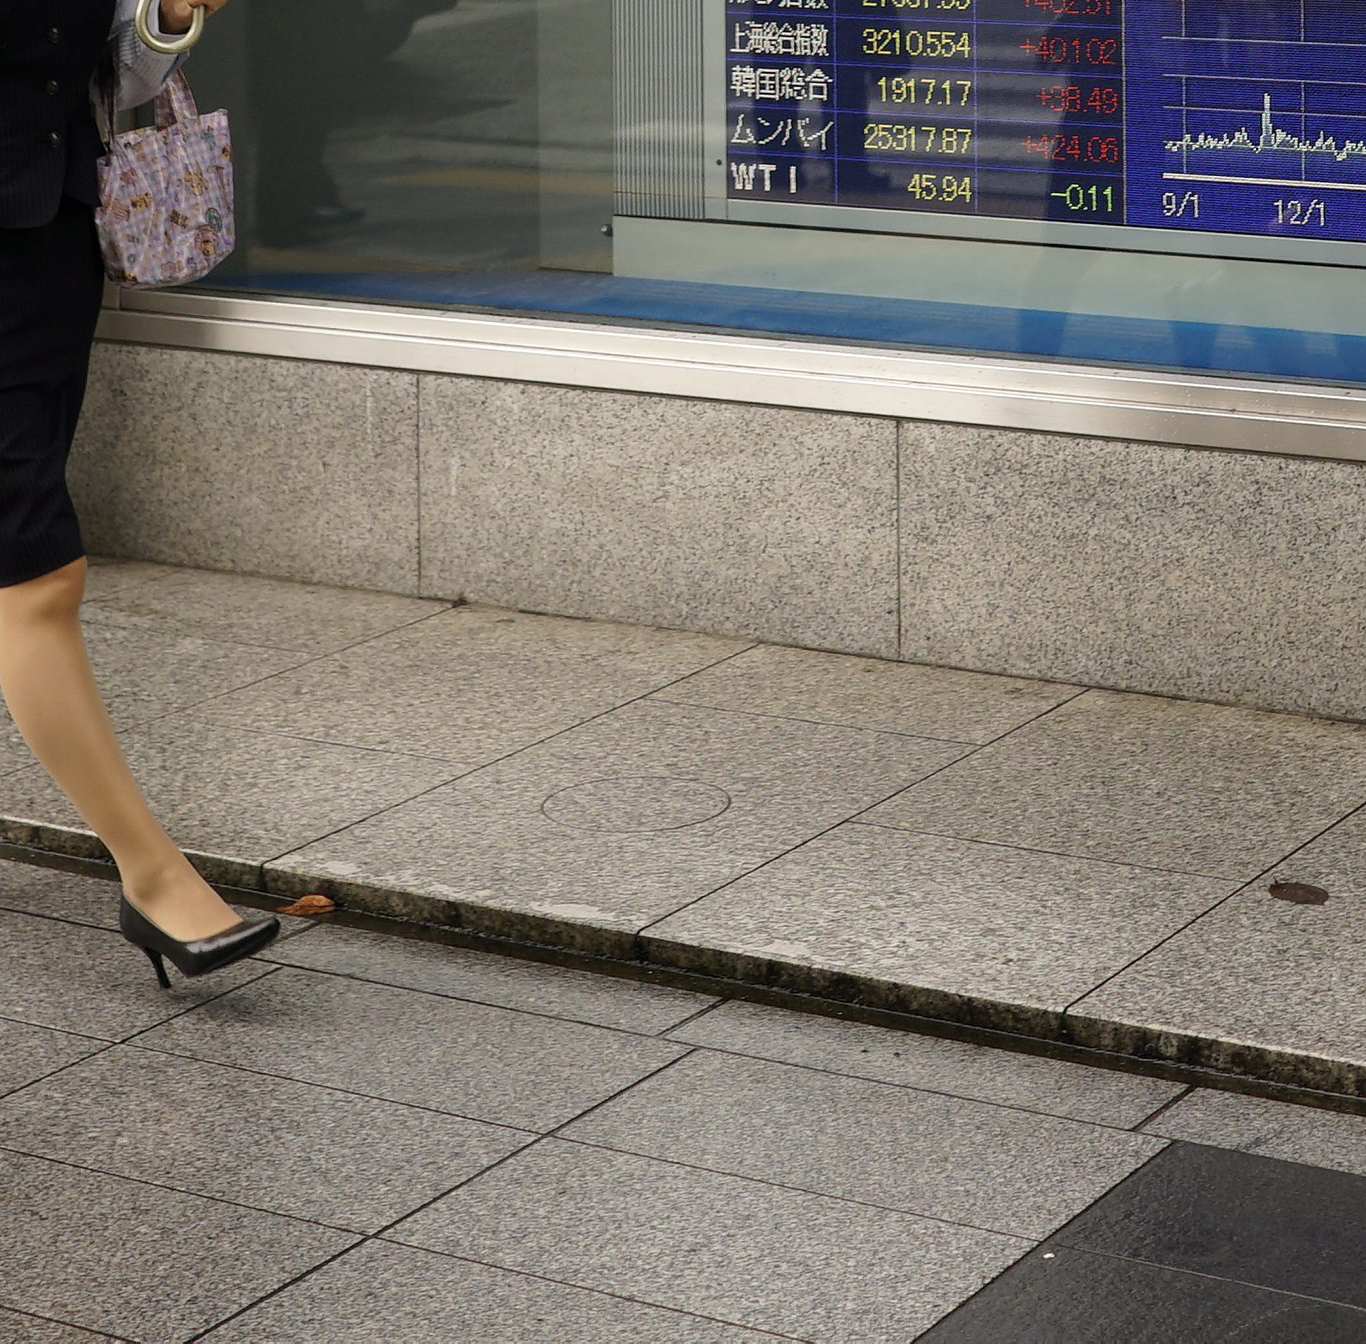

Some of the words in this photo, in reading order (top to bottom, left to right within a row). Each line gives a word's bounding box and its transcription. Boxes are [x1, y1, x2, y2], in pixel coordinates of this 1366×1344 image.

[729, 20, 829, 58] 上海総合指数
[862, 29, 970, 58] 3210.554
[730, 67, 833, 103] 韓国総合
[877, 78, 972, 107] 1917.17
[730, 113, 834, 151] ムンバイ
[863, 124, 972, 155] 25317.87
[1021, 132, 1118, 164] +424.06
[731, 161, 797, 194] WTI
[908, 173, 972, 203] 45.94
[1162, 192, 1199, 218] 9/1
[1274, 199, 1325, 226] 12/1
